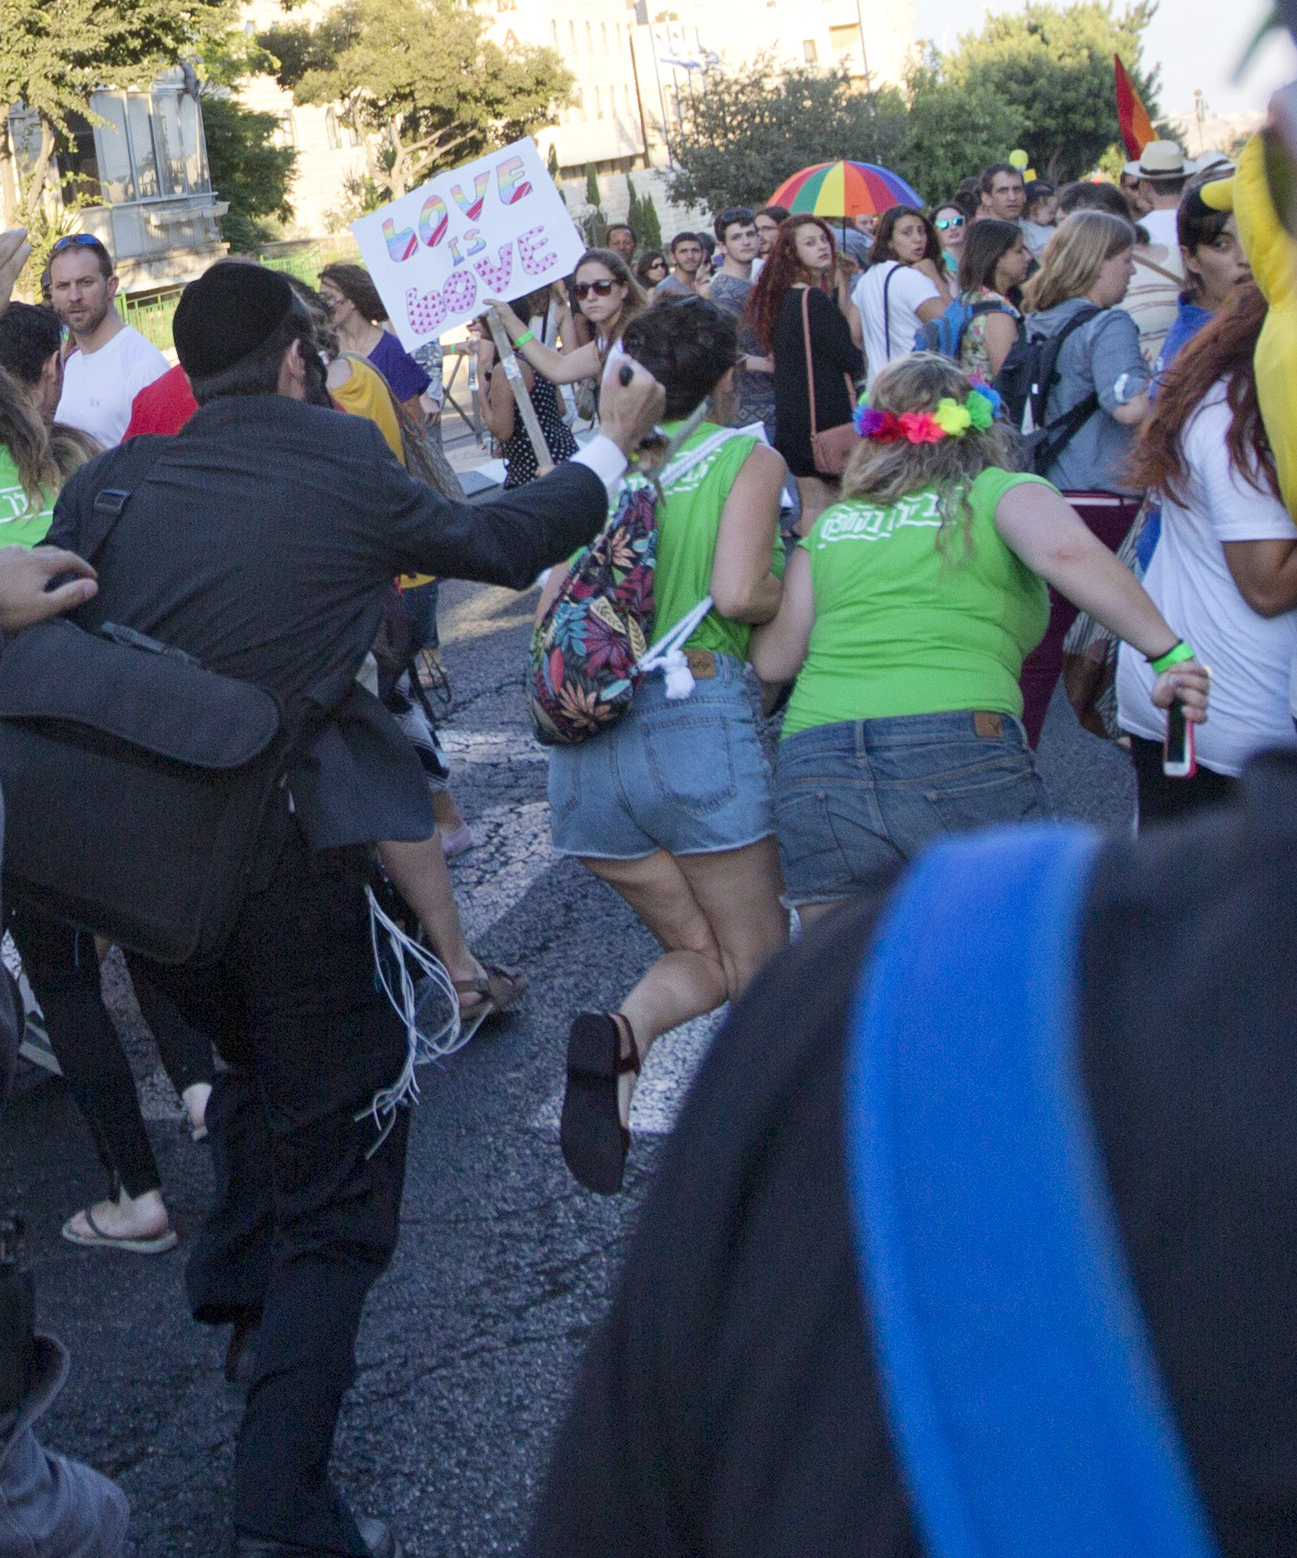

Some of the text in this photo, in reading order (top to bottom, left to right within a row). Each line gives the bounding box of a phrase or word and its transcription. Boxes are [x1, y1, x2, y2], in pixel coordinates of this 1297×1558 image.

[382, 155, 533, 262] LOVE
[448, 229, 487, 267] IS
[406, 225, 558, 335] LOVE
